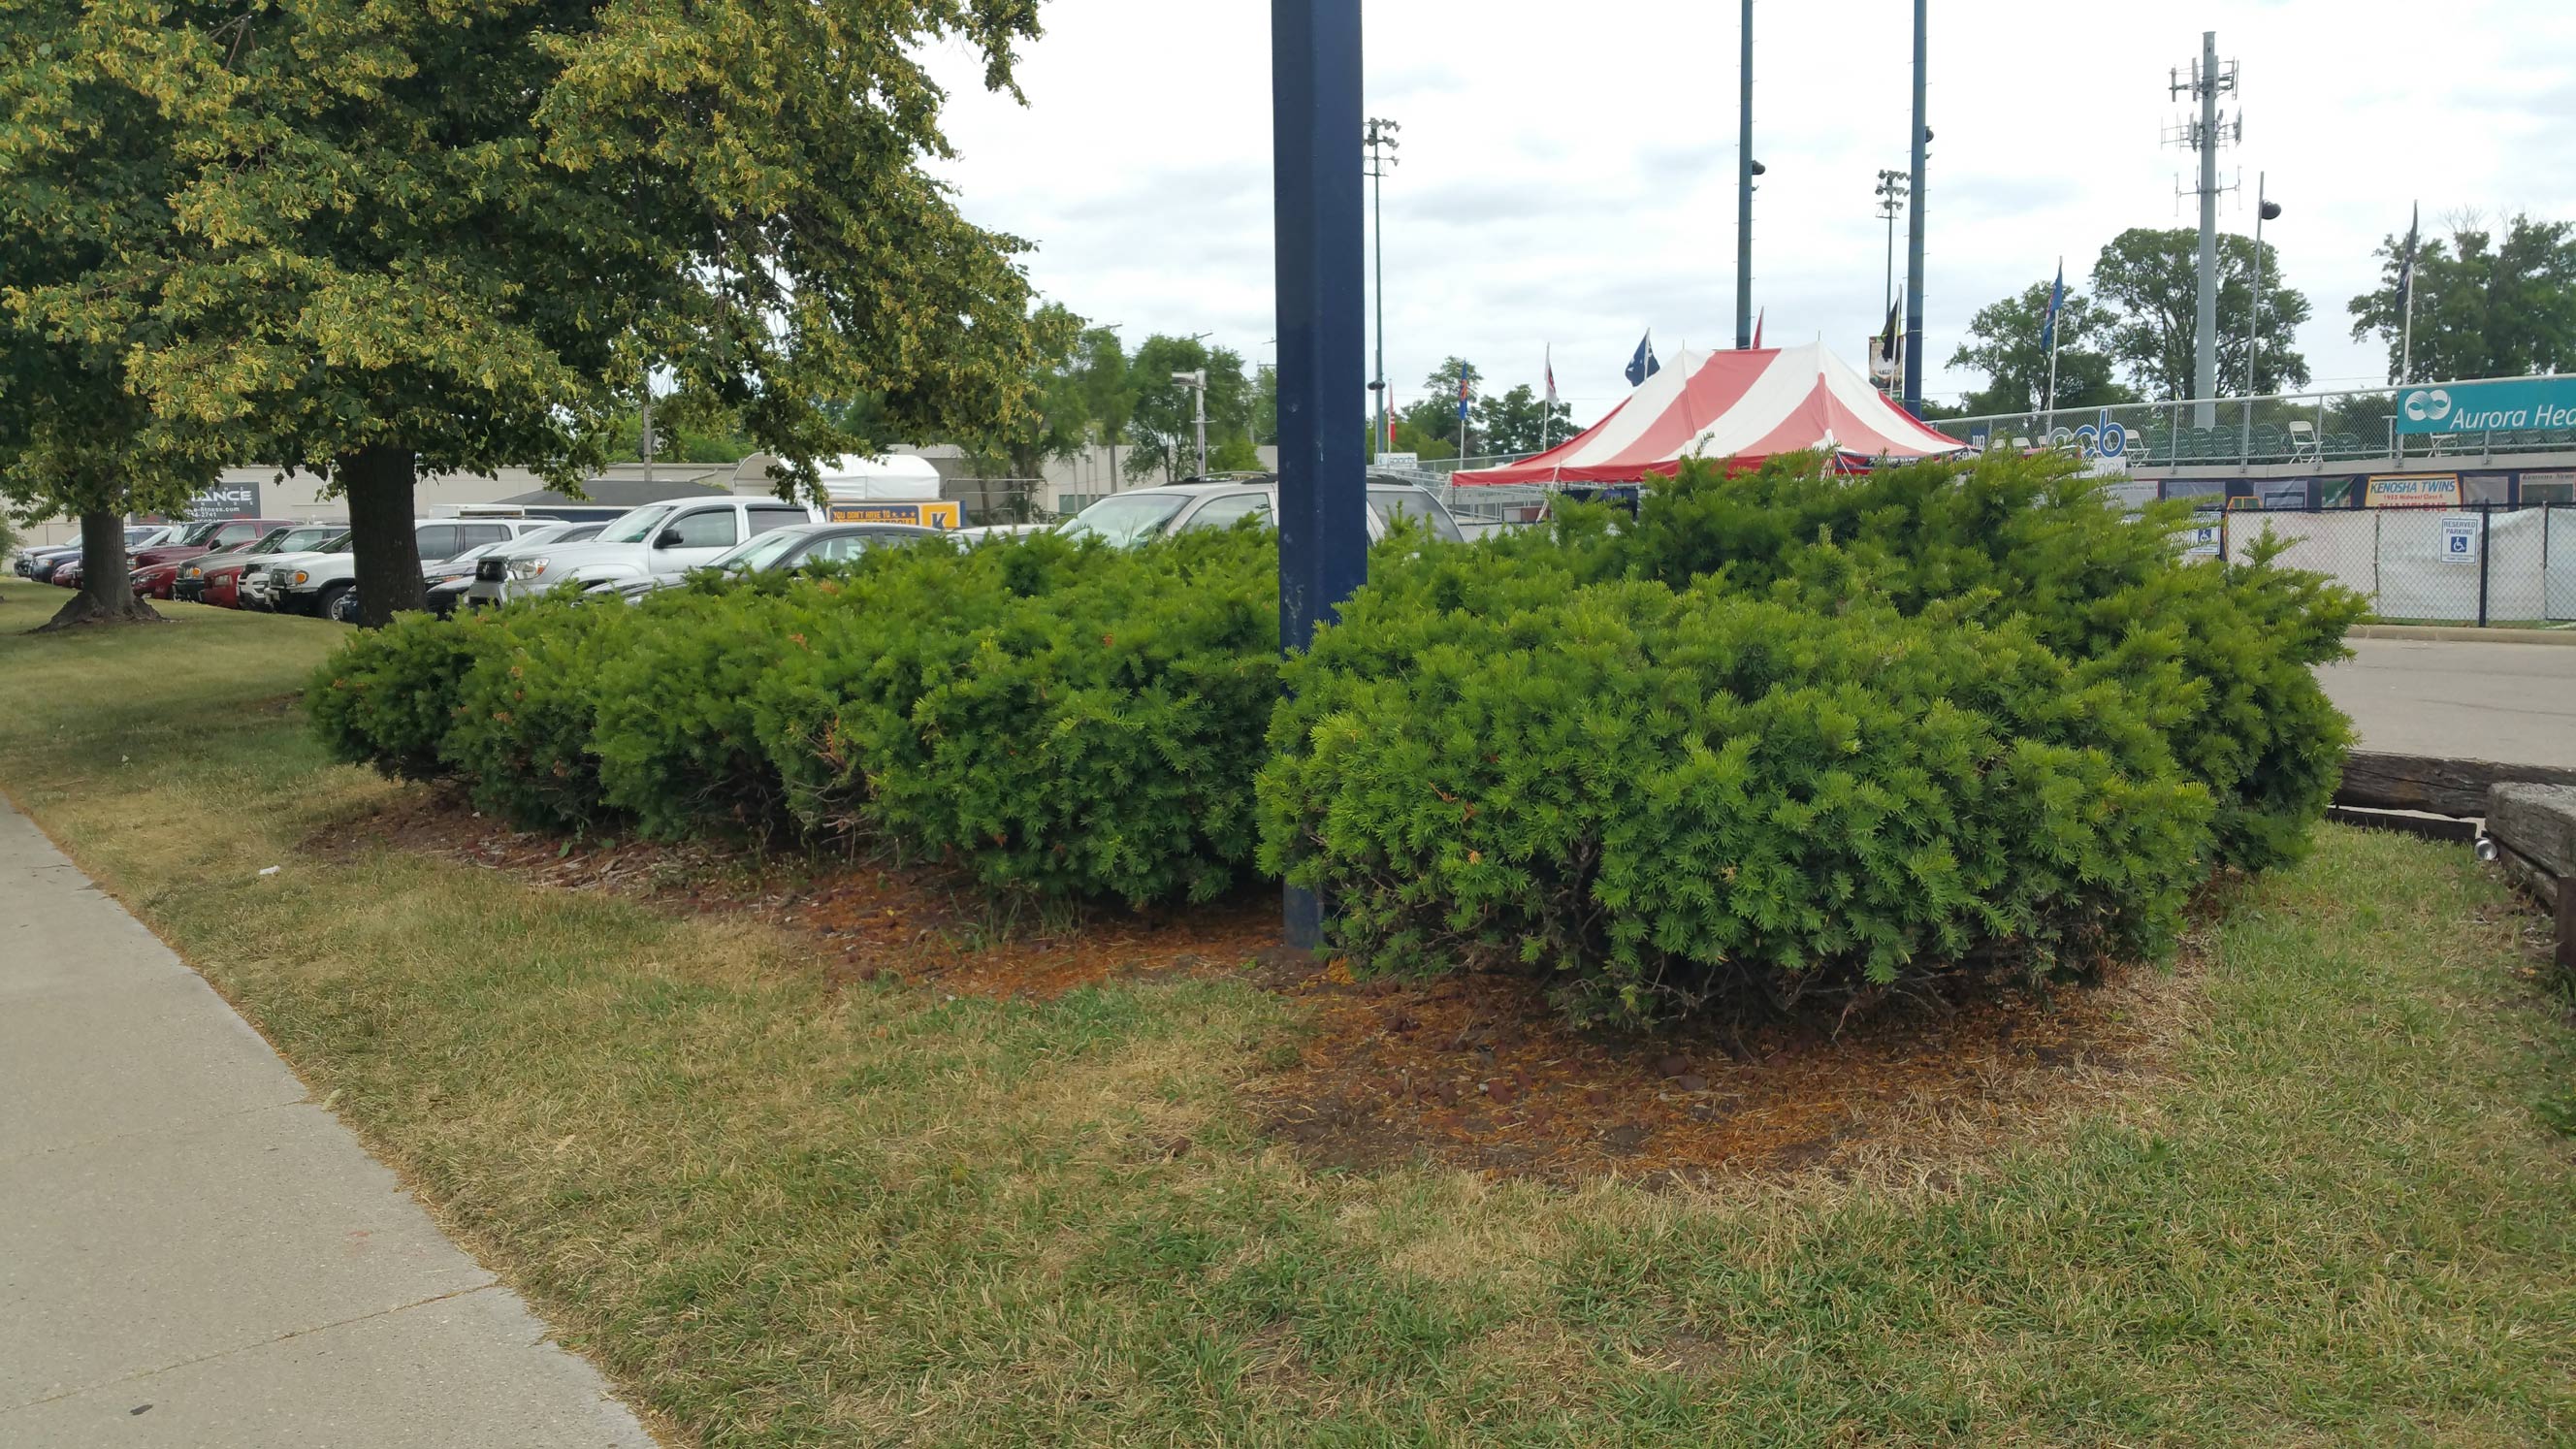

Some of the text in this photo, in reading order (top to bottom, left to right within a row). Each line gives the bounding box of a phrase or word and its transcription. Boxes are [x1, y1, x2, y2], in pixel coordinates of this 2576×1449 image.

[2450, 407, 2527, 430] Aurora
[2370, 480, 2456, 494] KENOSHA TWINS
